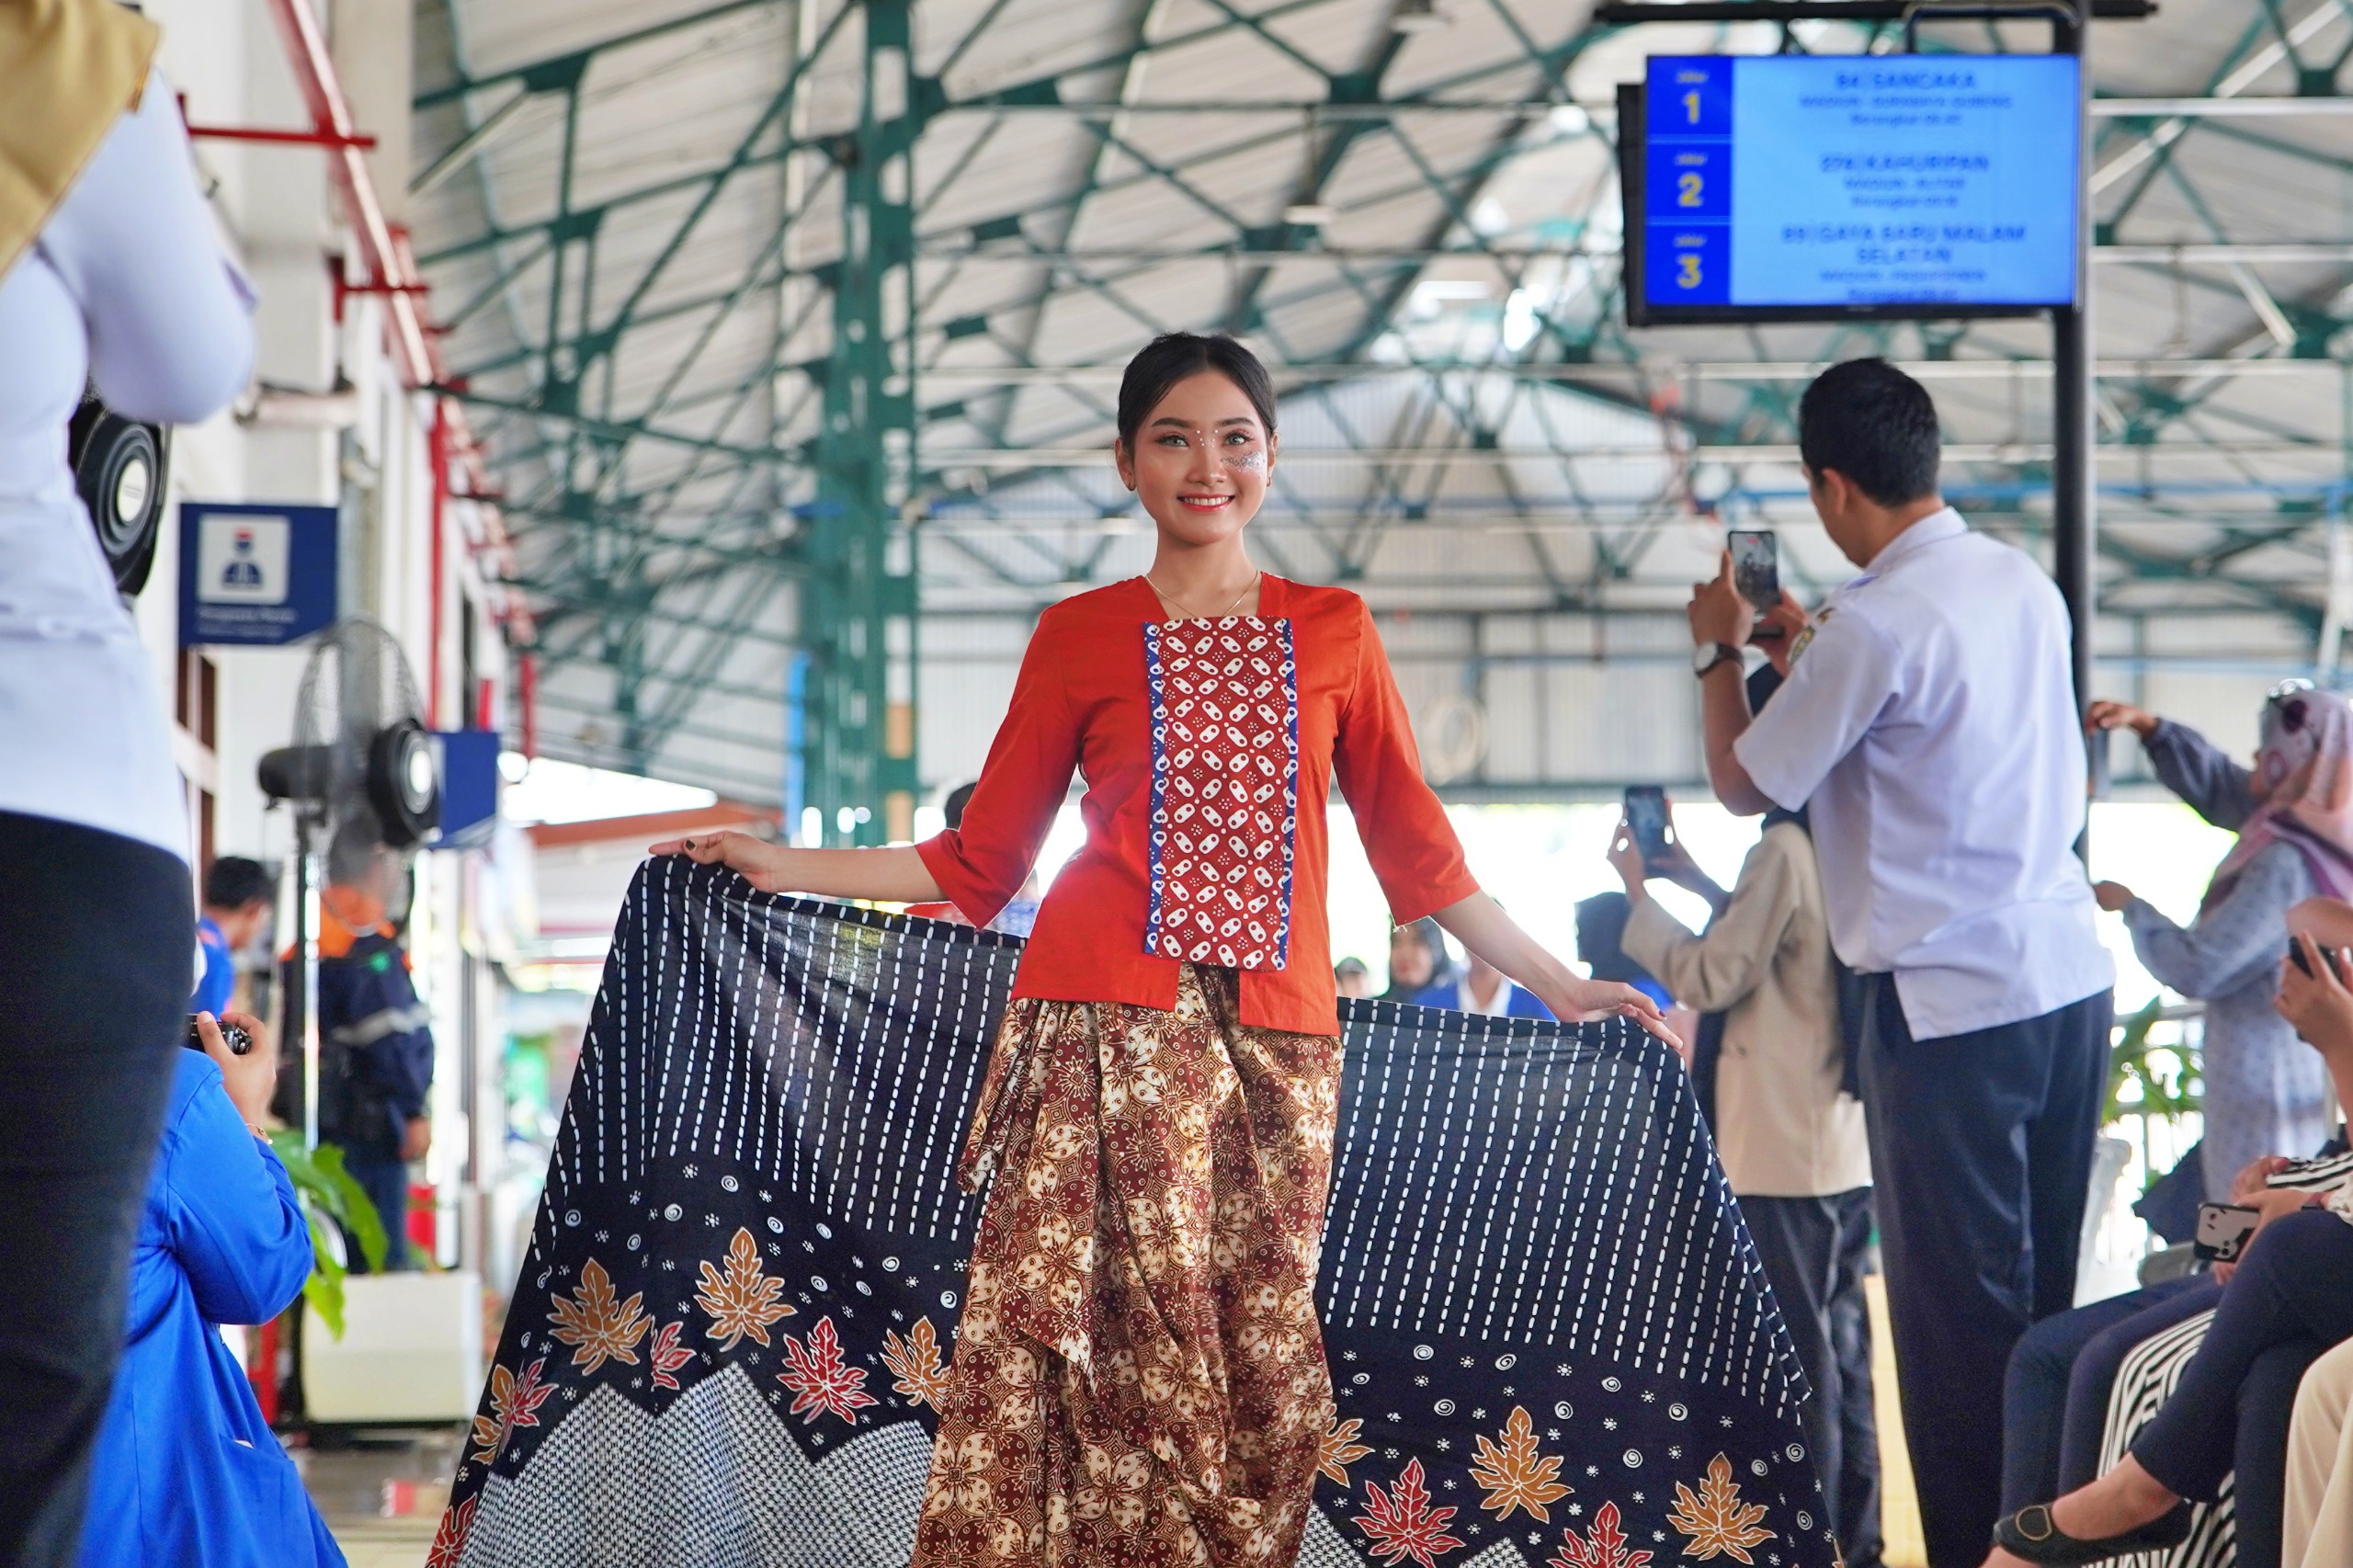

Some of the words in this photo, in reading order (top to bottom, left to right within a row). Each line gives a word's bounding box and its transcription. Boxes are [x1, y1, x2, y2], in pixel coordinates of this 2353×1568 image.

[1684, 91, 1699, 123] 1
[1677, 172, 1703, 207] 2
[1857, 246, 1951, 264] SELATAN
[1677, 255, 1702, 290] 3
